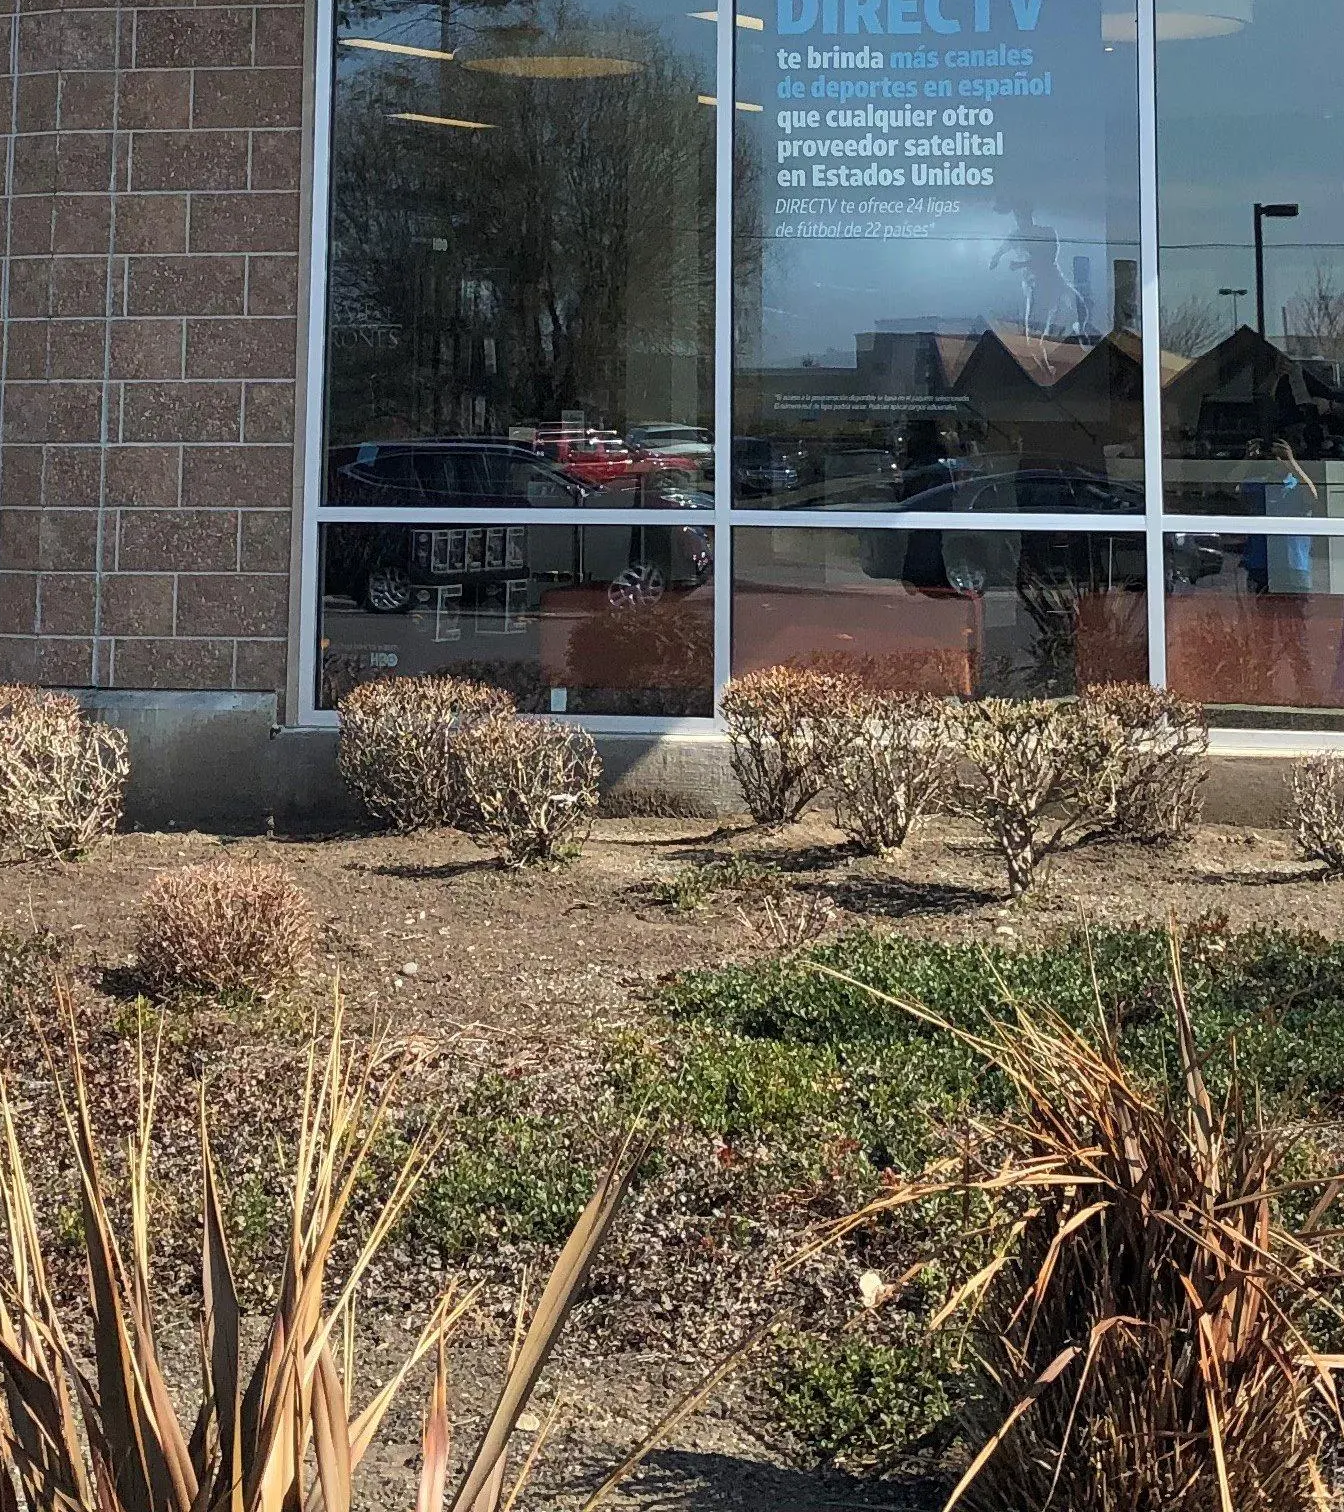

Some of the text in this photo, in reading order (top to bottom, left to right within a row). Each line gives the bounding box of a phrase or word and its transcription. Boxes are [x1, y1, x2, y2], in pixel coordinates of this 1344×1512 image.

[777, 43, 1034, 69] te brinda más canales
[777, 71, 1052, 103] de deportes en español
[777, 104, 994, 134] que cualquier otro
[777, 131, 1004, 163] proveedor satelital
[777, 162, 994, 187] en Estados Unidos
[775, 196, 960, 217] DIRECTV te ofrece 24 ligas
[775, 222, 793, 238] de
[844, 222, 862, 238] de
[864, 221, 880, 238] 22
